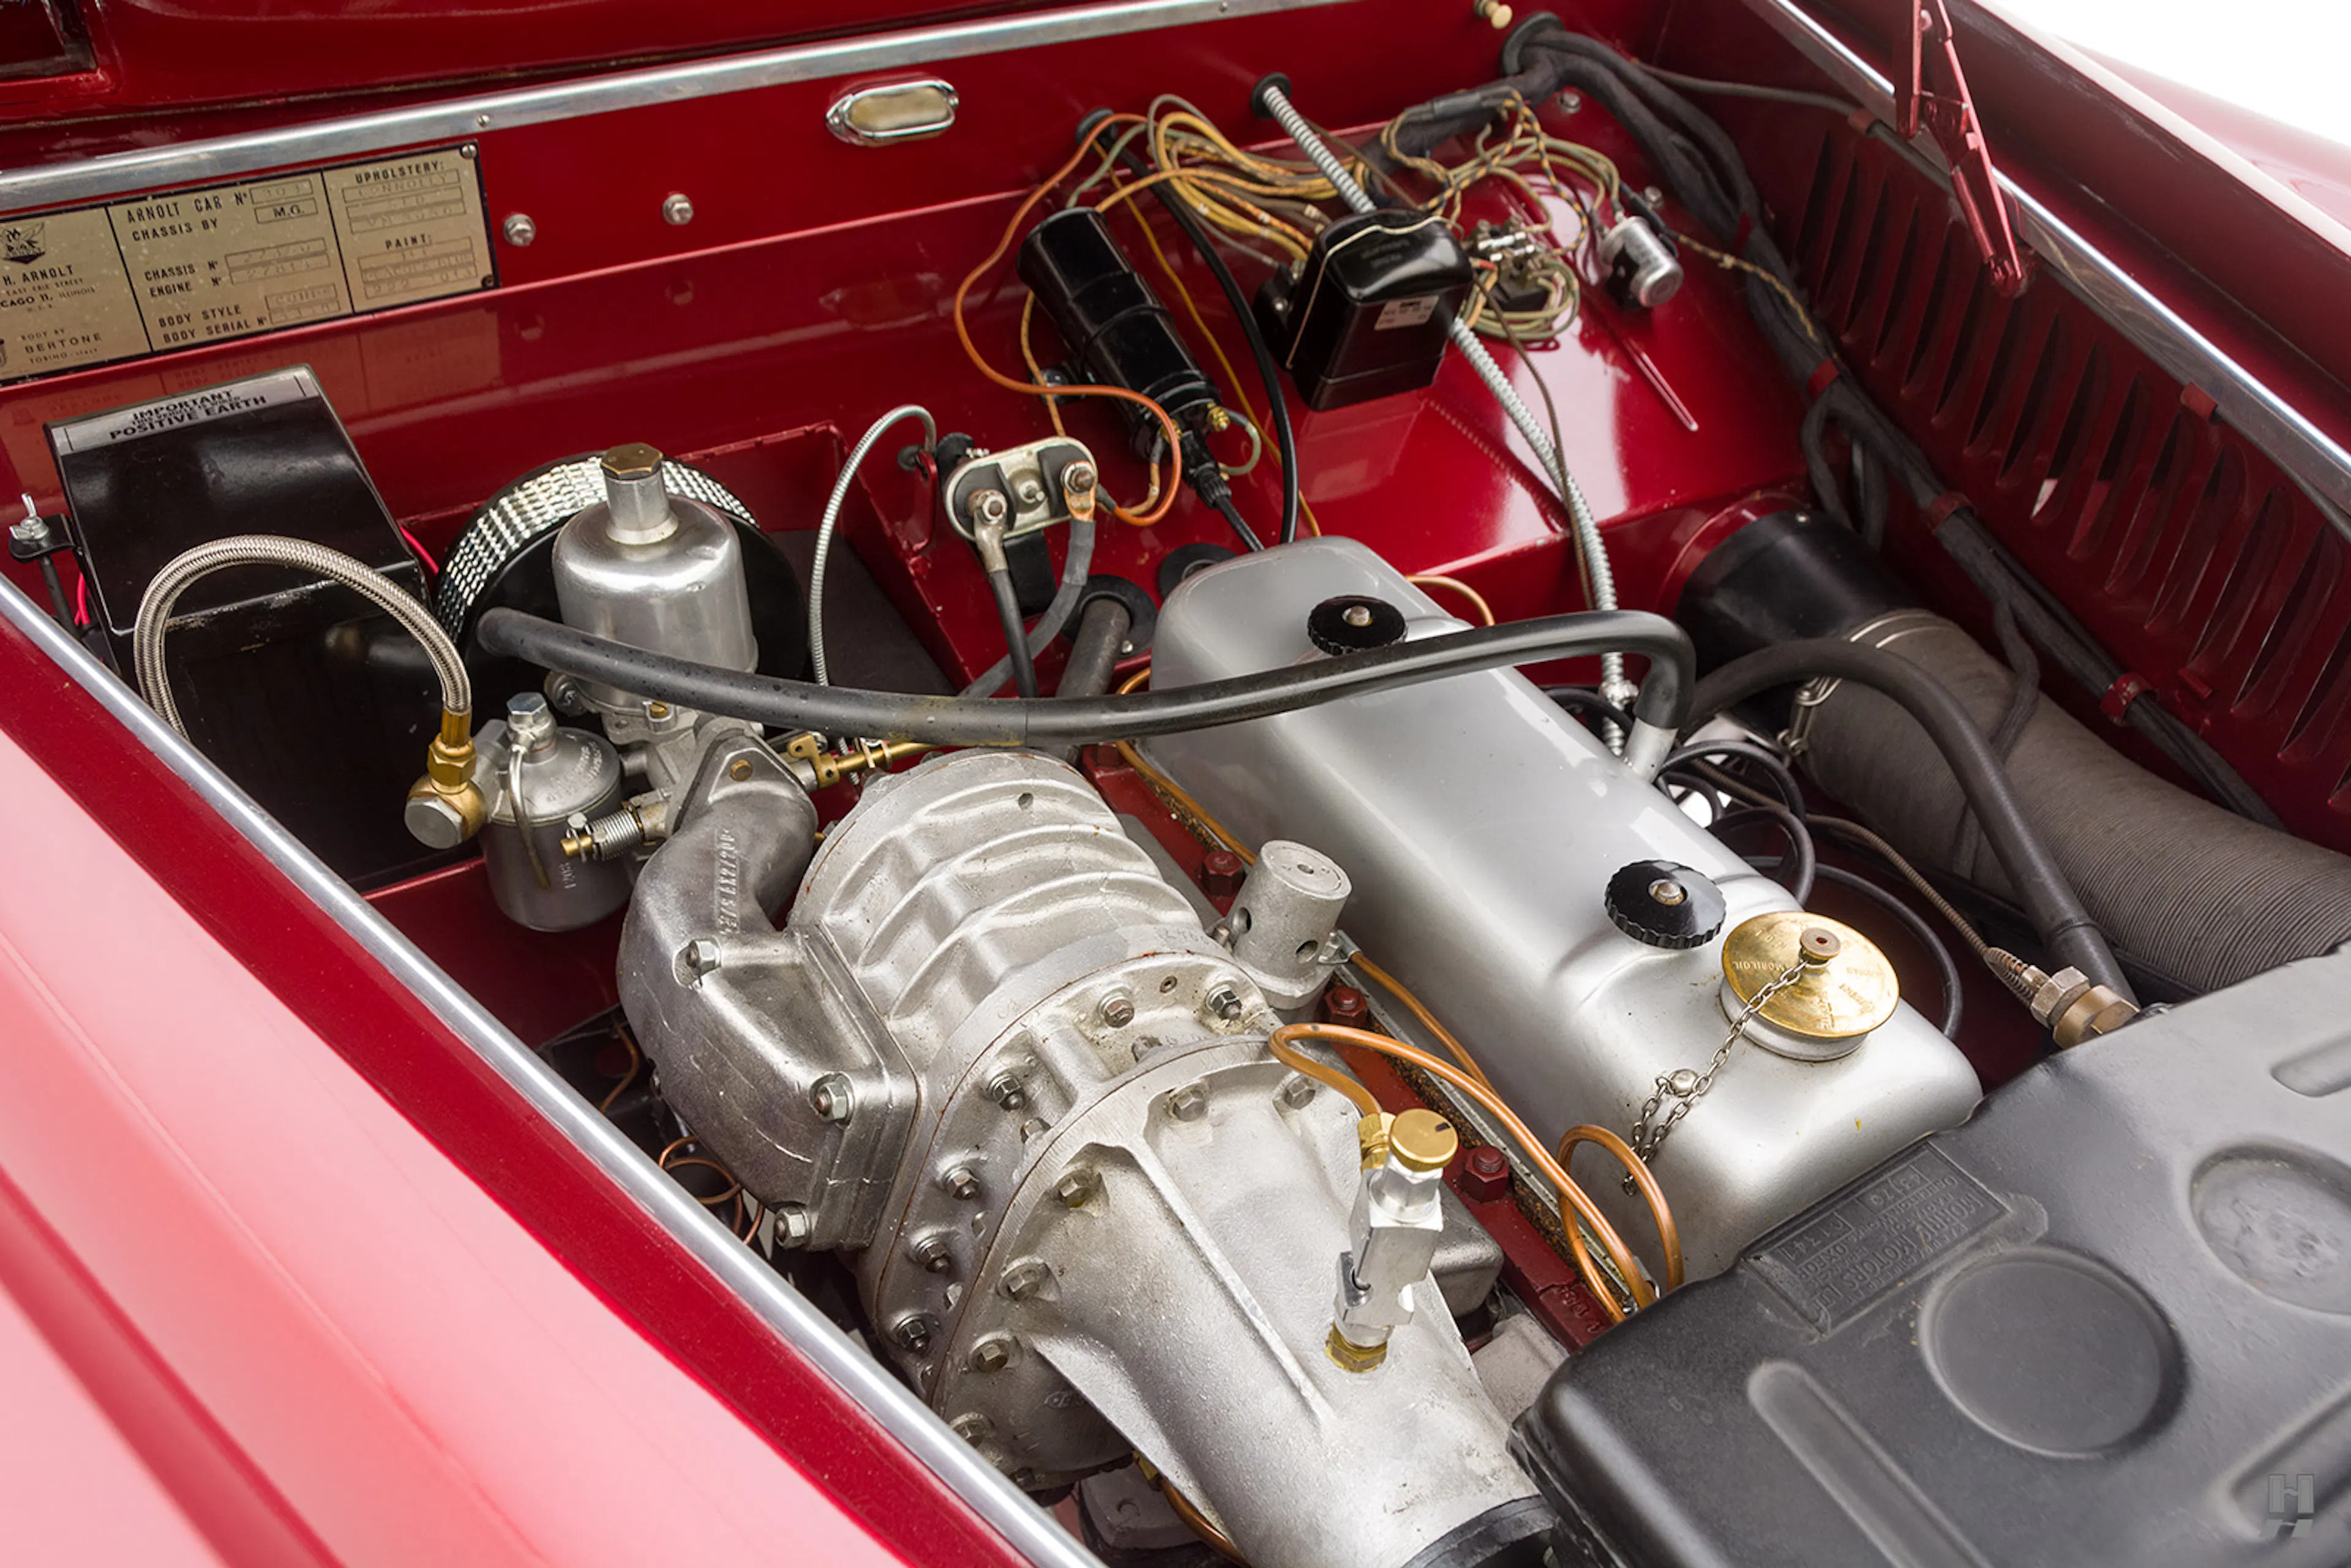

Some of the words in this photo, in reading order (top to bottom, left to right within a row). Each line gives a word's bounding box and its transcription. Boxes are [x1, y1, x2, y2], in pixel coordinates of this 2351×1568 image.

[355, 160, 443, 184] UPHOLSTERY:
[127, 201, 180, 223] ARNOLT
[194, 195, 222, 213] CAR
[132, 222, 192, 241] CHASSIS
[201, 217, 218, 230] BY
[22, 264, 73, 283] ARNOLT
[144, 263, 196, 282] CHASSIS
[149, 281, 193, 298] ENGINE
[159, 313, 192, 328] BODY
[201, 304, 242, 320] STYLE
[25, 332, 102, 353] BERTONE
[163, 329, 197, 344] BODY
[206, 318, 252, 336] SERIAL
[133, 390, 232, 420] IMPORTANT
[110, 412, 200, 439] POSITIVE
[205, 396, 266, 417] EARTH
[1911, 1191, 1985, 1244] MORRIS
[1837, 1234, 1918, 1291] MOTORS
